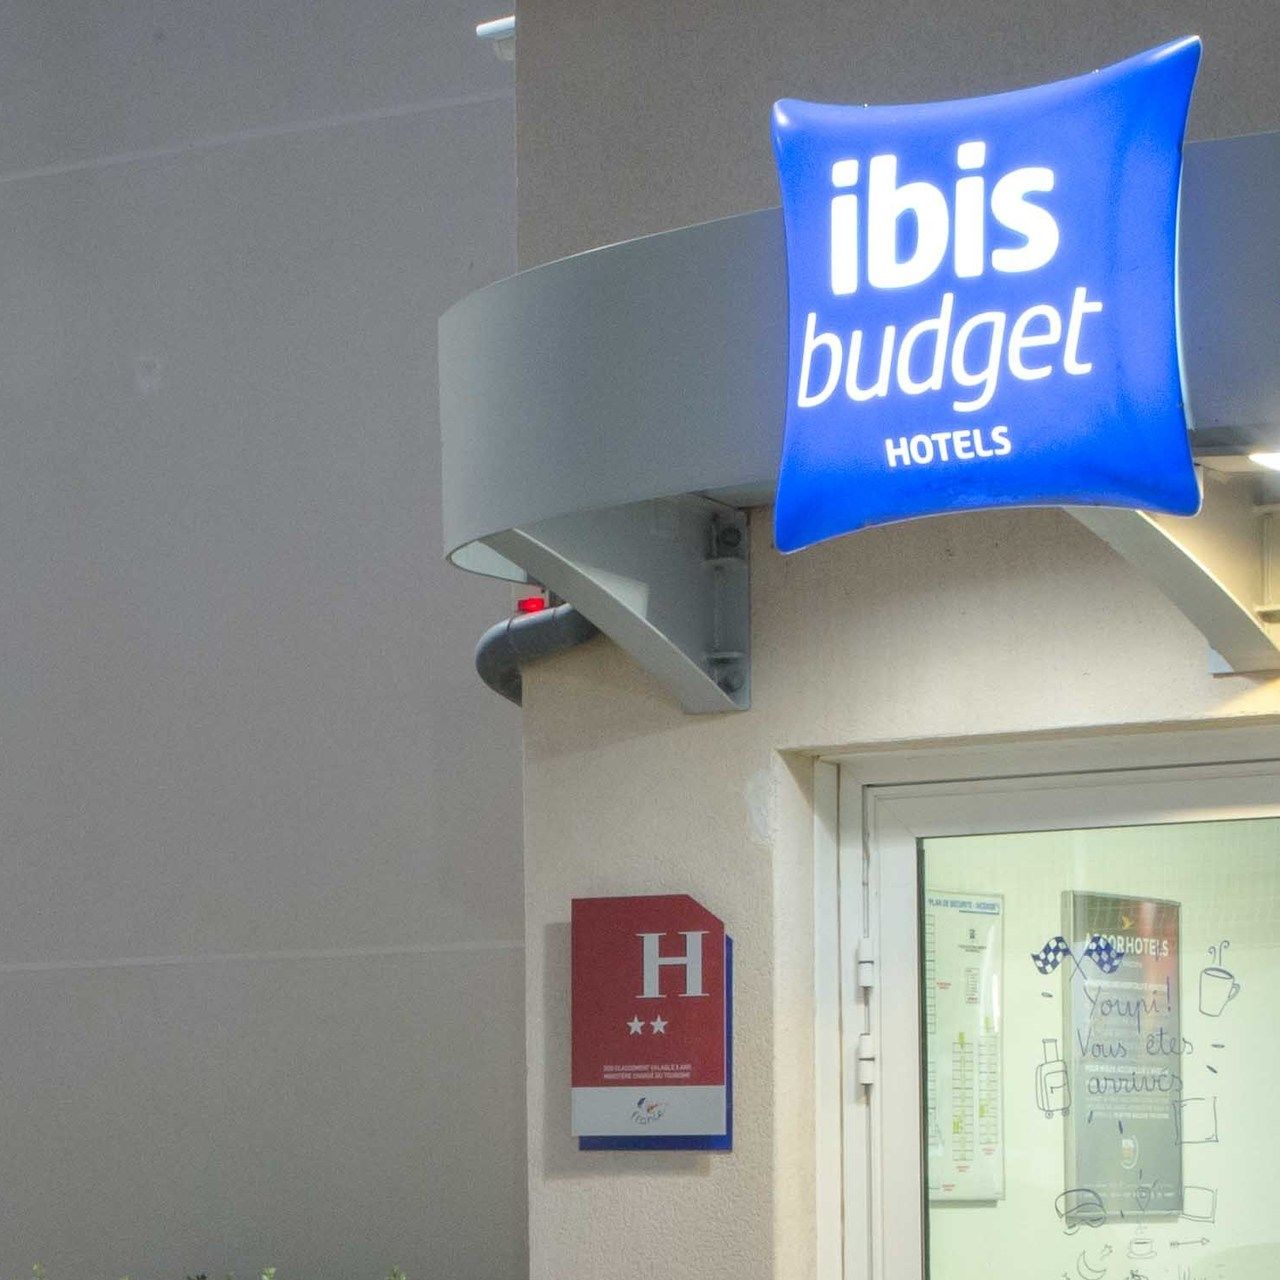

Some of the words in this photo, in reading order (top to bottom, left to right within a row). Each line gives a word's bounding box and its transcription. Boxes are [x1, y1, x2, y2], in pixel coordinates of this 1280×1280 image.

[830, 141, 1060, 296] ibis
[797, 286, 1103, 412] budget
[884, 425, 1012, 468] HOTELS
[635, 930, 710, 999] H
[1083, 932, 1169, 958] AORHOTELS
[1077, 1022, 1128, 1058] Vous
[1146, 1026, 1194, 1056] êtes
[1088, 1067, 1184, 1095] arrivés
